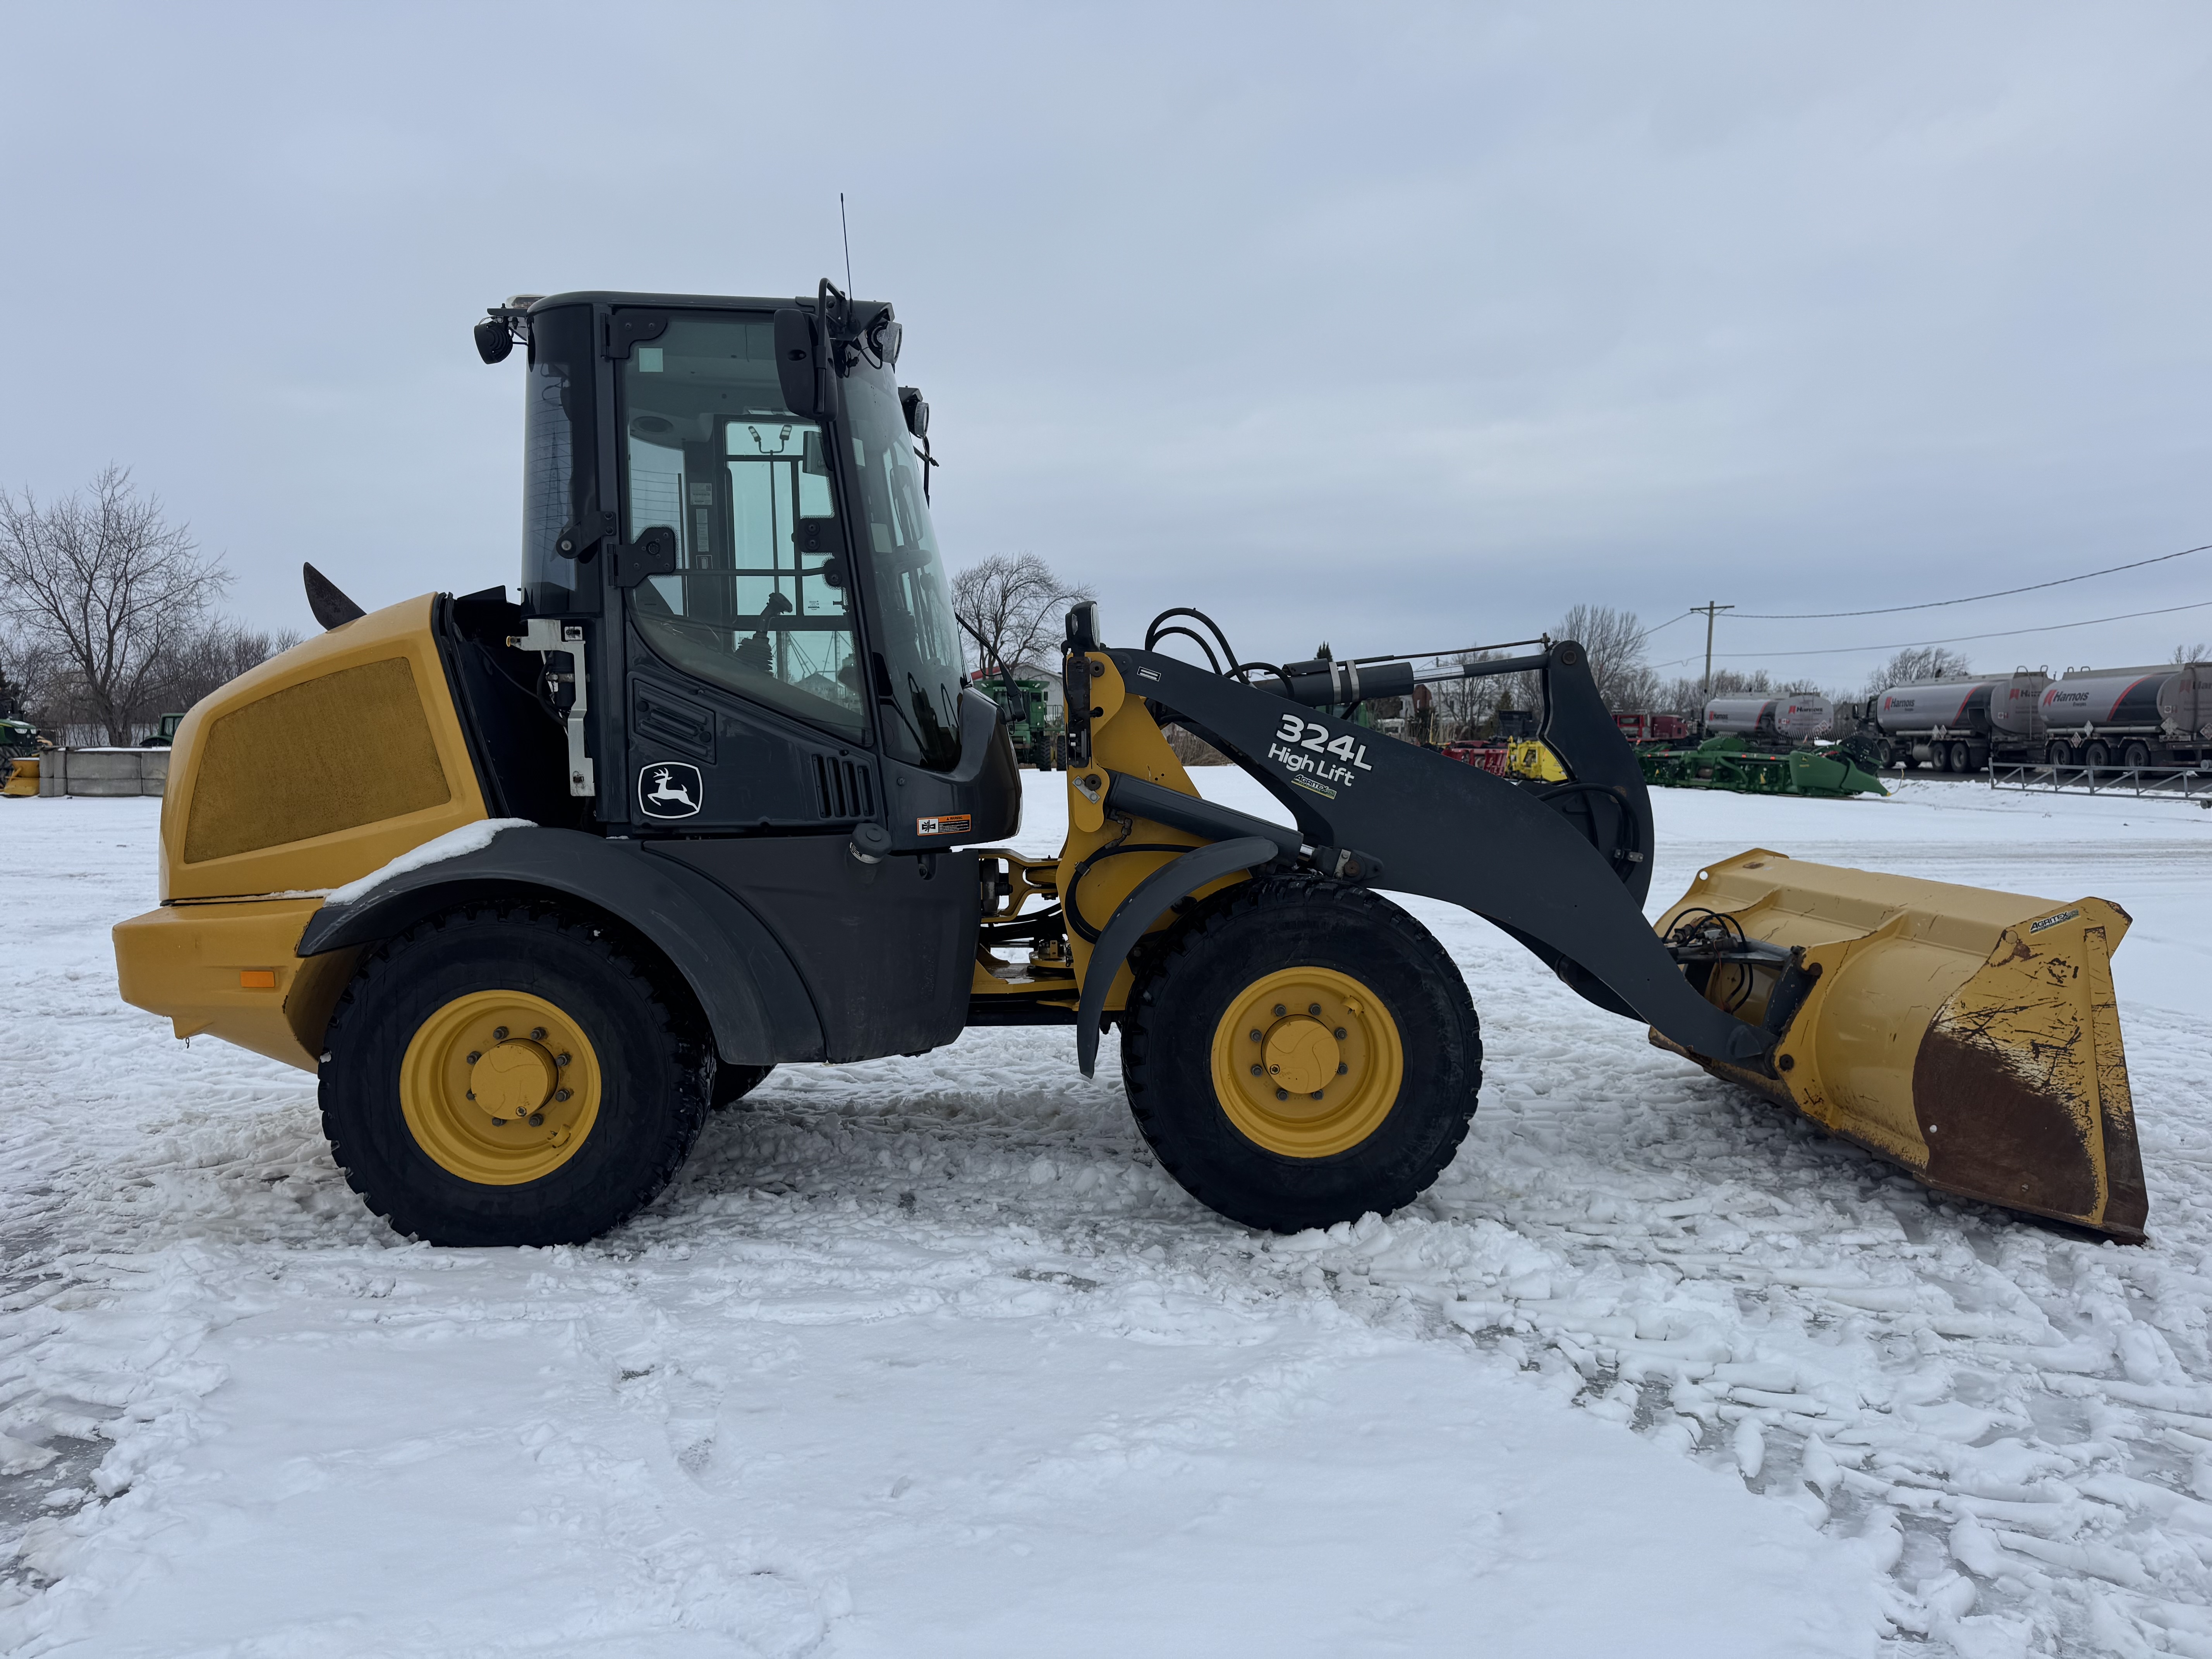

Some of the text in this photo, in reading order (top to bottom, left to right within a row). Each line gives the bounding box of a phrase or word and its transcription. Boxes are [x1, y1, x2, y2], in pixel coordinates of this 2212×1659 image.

[1891, 698, 1915, 708] Harnois
[2053, 691, 2089, 702] Harnois
[1276, 714, 1372, 771] 324L
[1267, 743, 1355, 787] High Lift
[1295, 775, 1328, 792] AGRITEX
[2030, 912, 2069, 931] AGRITEX
